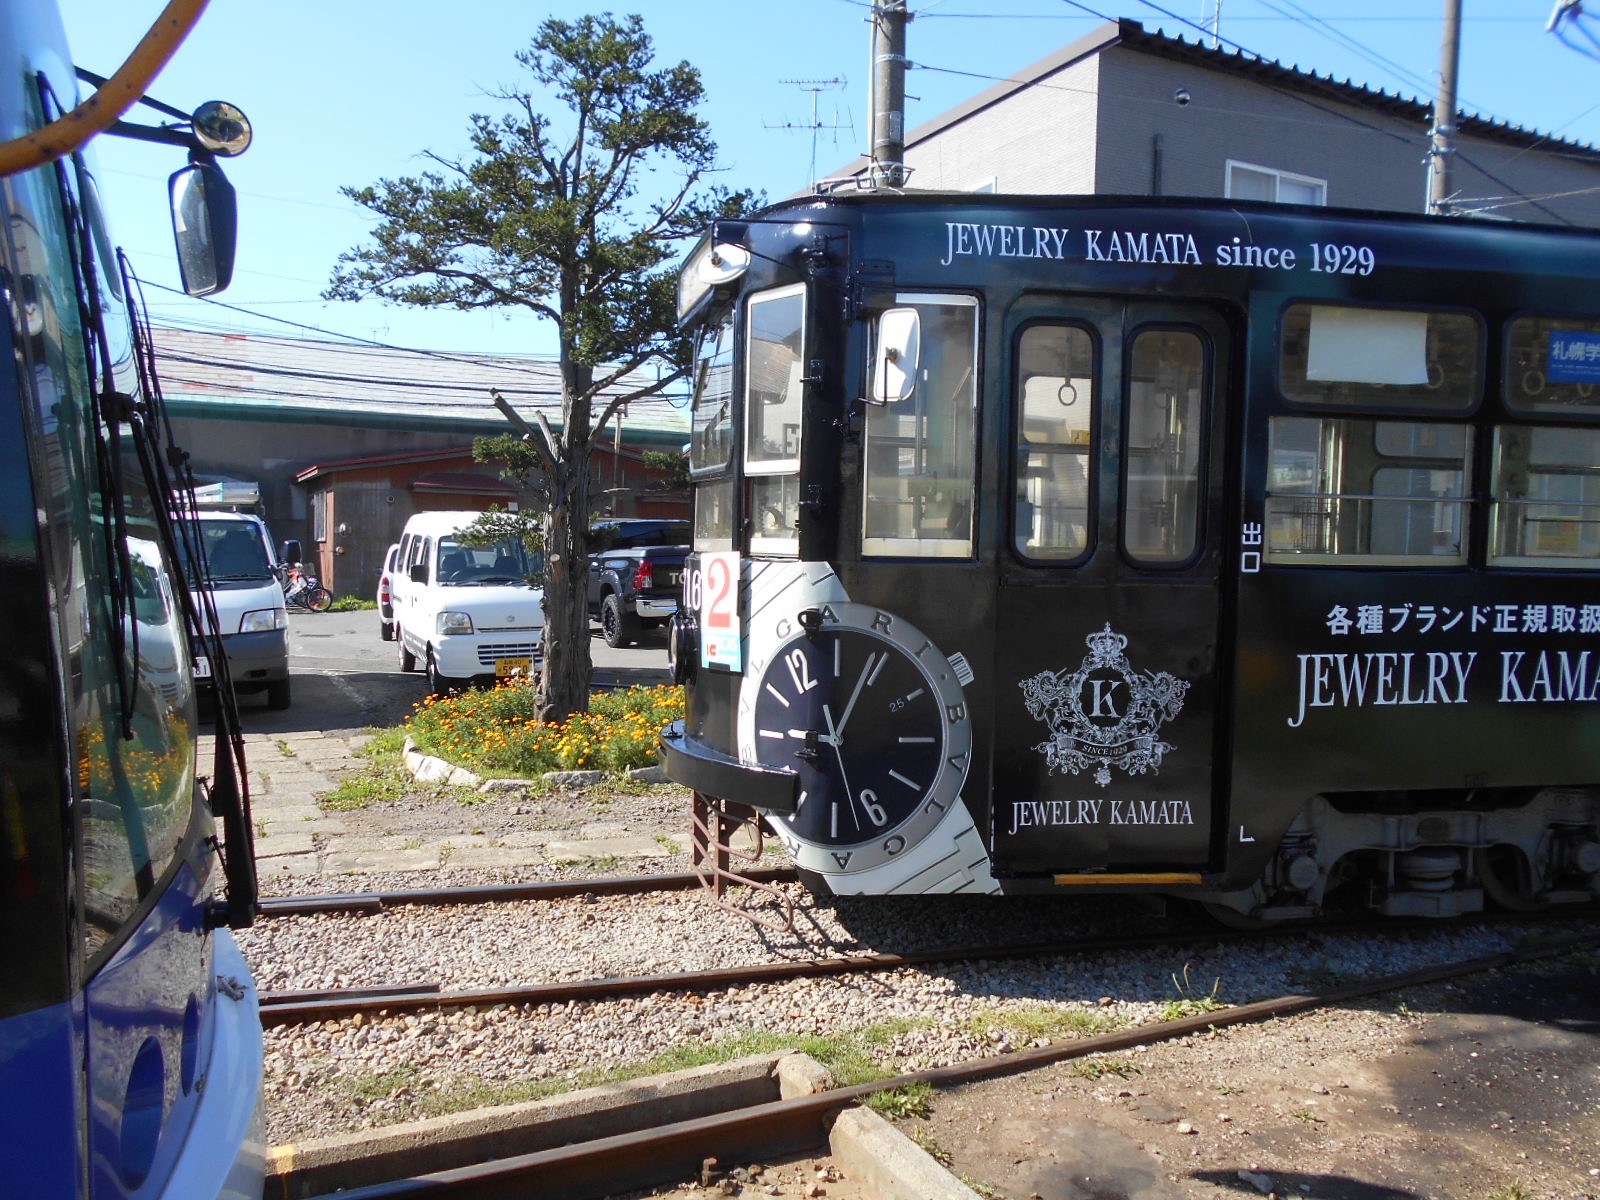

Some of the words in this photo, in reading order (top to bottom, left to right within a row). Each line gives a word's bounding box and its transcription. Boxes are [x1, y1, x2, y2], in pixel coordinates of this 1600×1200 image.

[940, 222, 1069, 266] JEWELRY
[1084, 229, 1203, 265] KAMATA
[1216, 237, 1296, 271] since
[1310, 242, 1376, 276] 1929
[1241, 521, 1261, 573] 出口
[707, 557, 731, 628] 2
[1326, 603, 1600, 636] 各種ブランド正規取扱
[784, 647, 819, 695] 12
[1287, 651, 1478, 728] JEWELRY
[889, 697, 904, 713] 25
[1089, 680, 1123, 718] K
[859, 788, 888, 827] 6
[1008, 799, 1104, 836] JEWELRY
[1109, 799, 1194, 825] KAMATA
